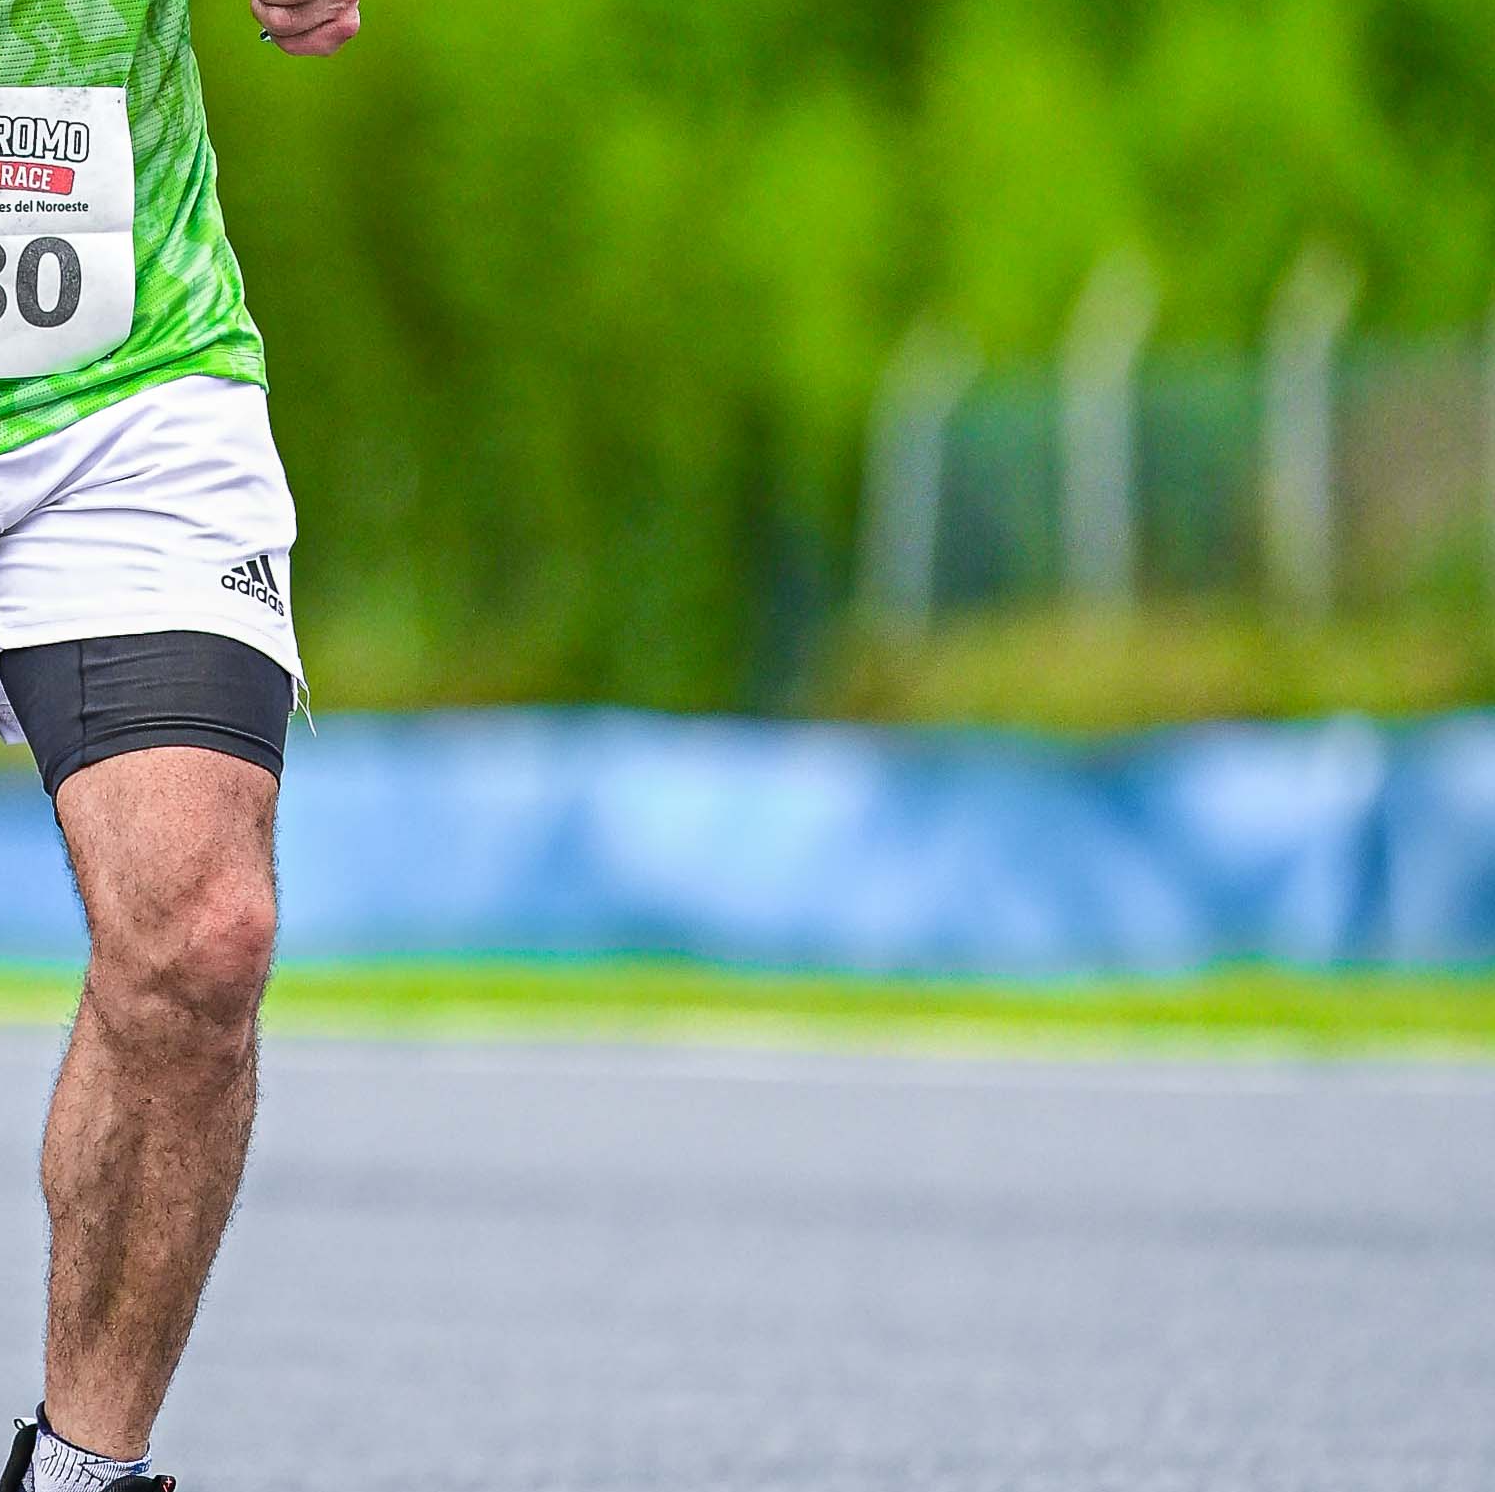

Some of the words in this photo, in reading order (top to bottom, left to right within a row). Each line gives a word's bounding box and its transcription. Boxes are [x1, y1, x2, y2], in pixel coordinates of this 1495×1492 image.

[0, 167, 54, 191] RACE
[14, 199, 33, 213] del
[36, 200, 89, 213] Noroeste
[221, 574, 284, 617] adidas
